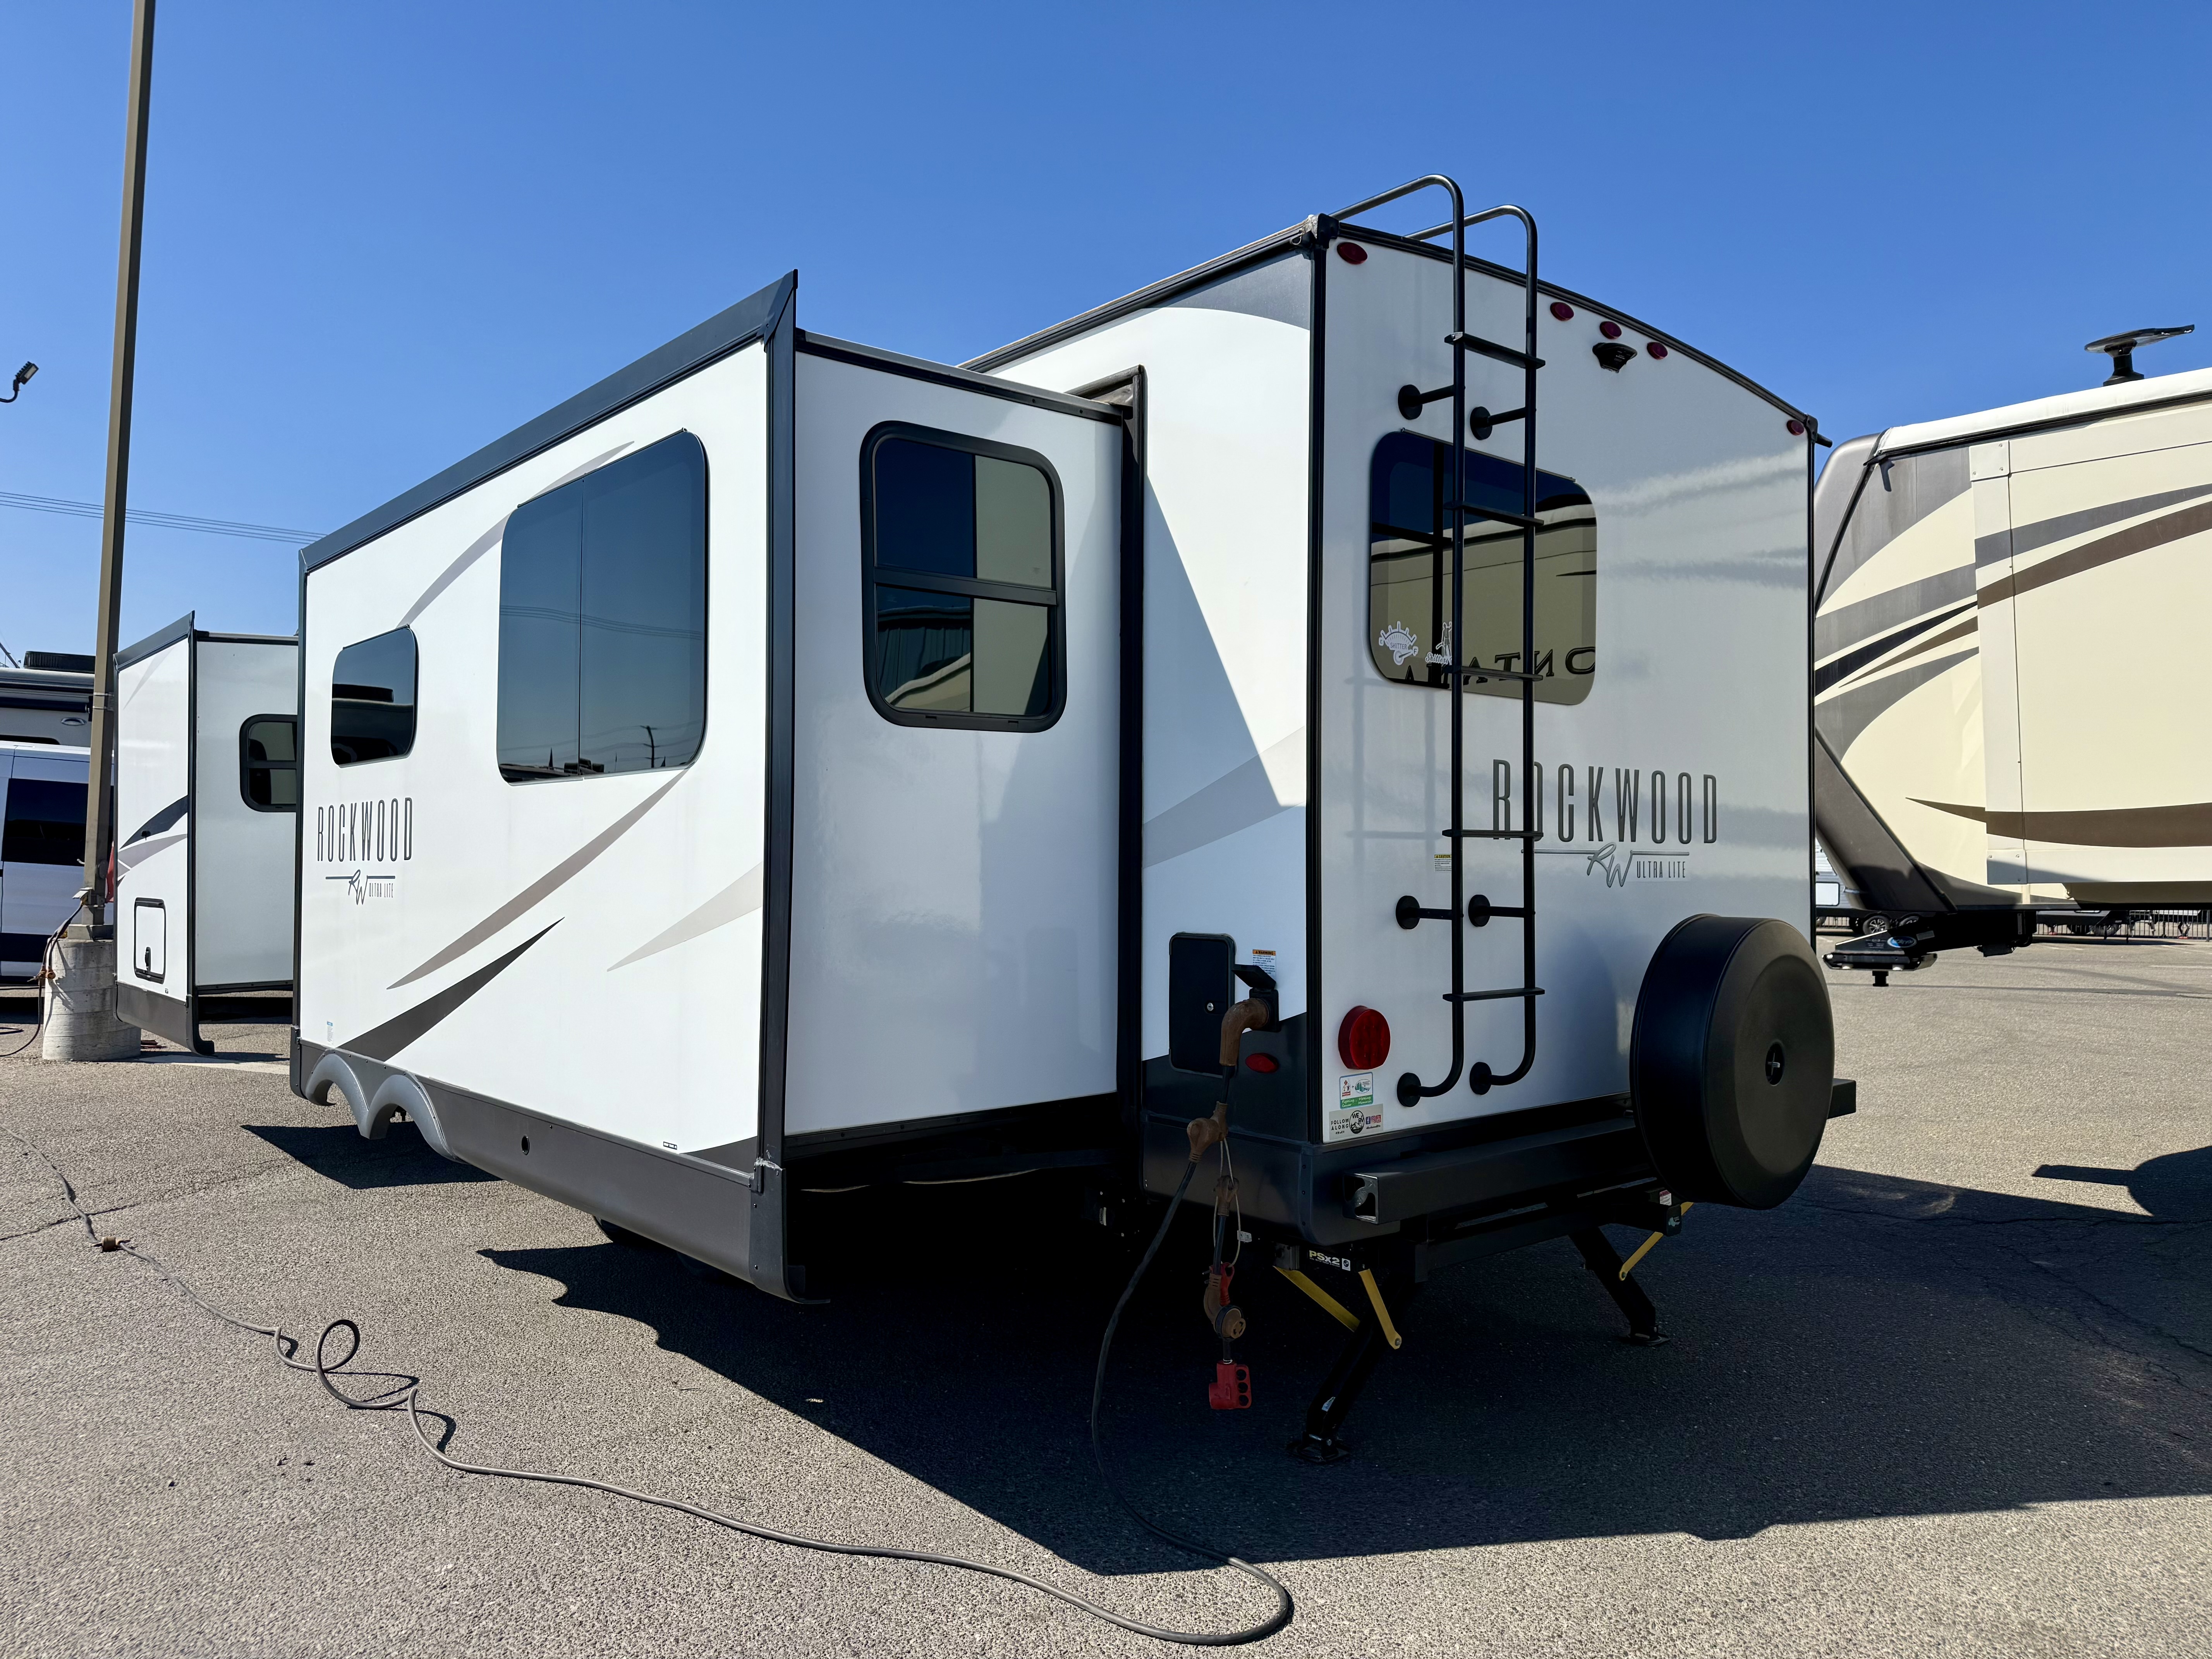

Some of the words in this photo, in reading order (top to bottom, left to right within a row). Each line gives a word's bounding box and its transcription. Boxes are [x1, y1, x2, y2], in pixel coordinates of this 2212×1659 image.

[317, 797, 412, 862] ROCKWOOD
[1637, 861, 1663, 878] ULTRA
[1668, 861, 1686, 878] LITE
[1309, 1250, 1340, 1266] PSx2
